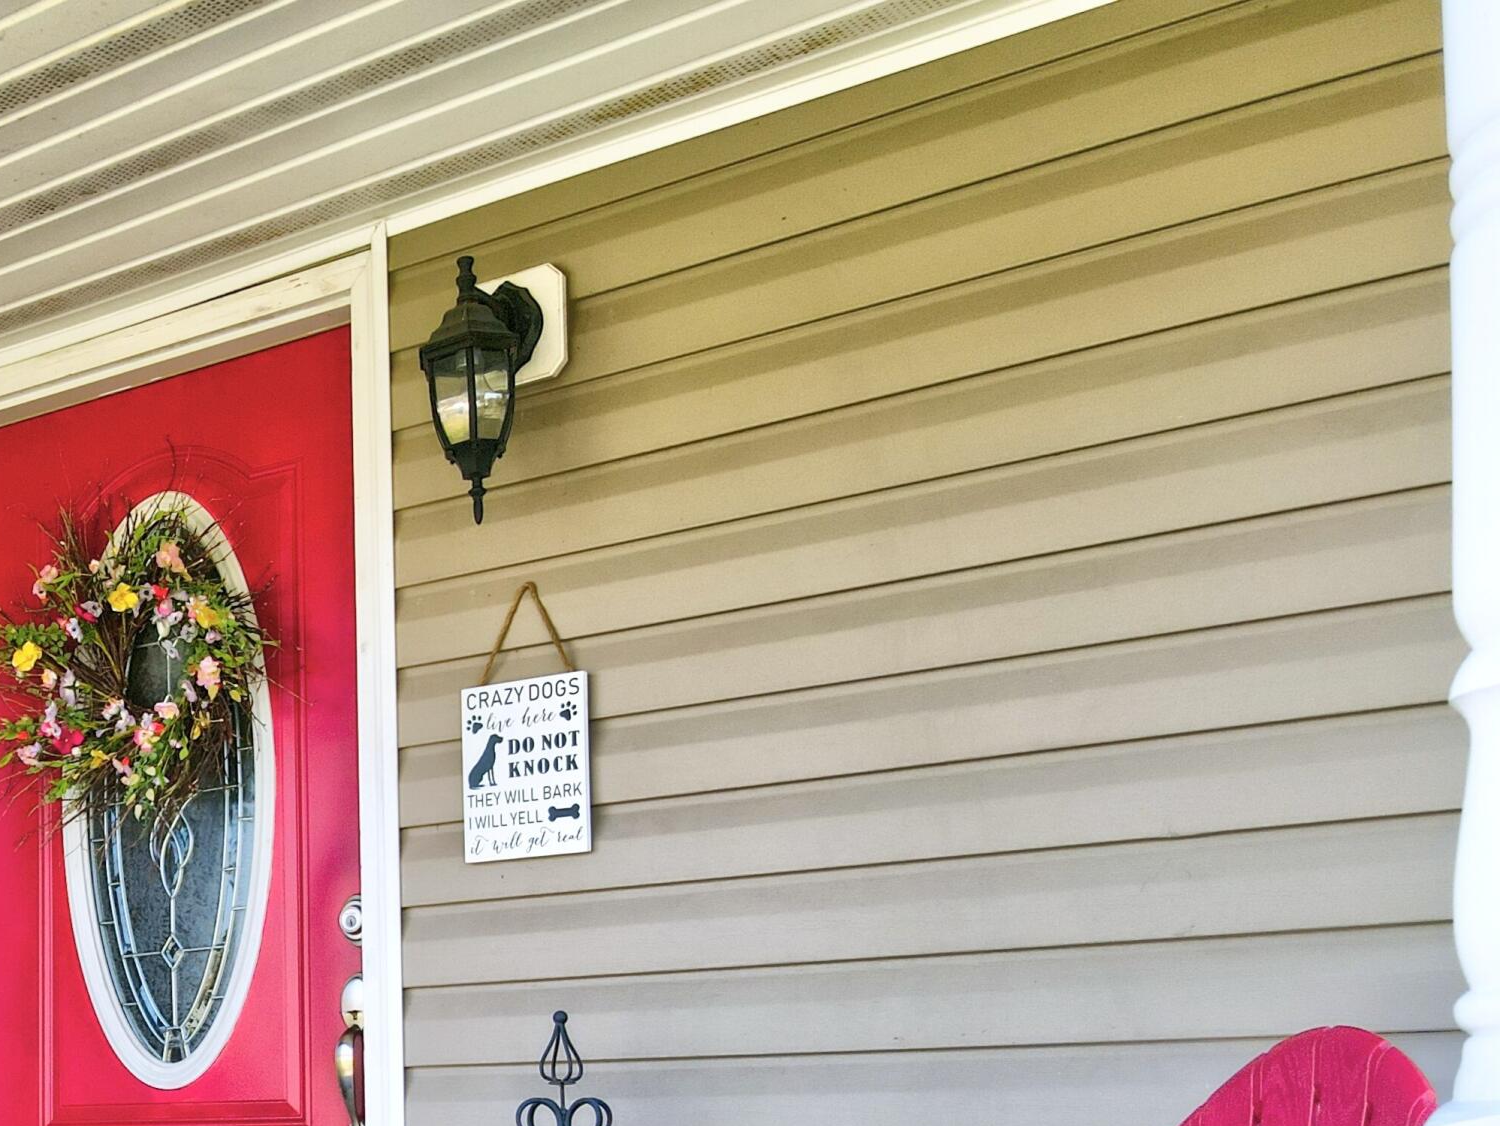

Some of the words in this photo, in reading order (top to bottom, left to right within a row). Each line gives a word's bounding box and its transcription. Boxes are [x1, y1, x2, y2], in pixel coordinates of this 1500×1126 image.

[466, 685, 525, 711] CRAZY
[528, 677, 580, 702] DOGS
[486, 712, 515, 733] live
[521, 706, 556, 728] here
[508, 737, 535, 756] DO
[541, 730, 580, 751] NOT
[508, 753, 579, 779] KNOCK
[467, 791, 502, 809] THEY
[504, 787, 539, 805] WILL
[543, 782, 583, 800] BARK
[468, 817, 473, 830] I
[475, 813, 508, 829] WILL
[510, 809, 544, 826] YELL
[557, 825, 584, 843] real
